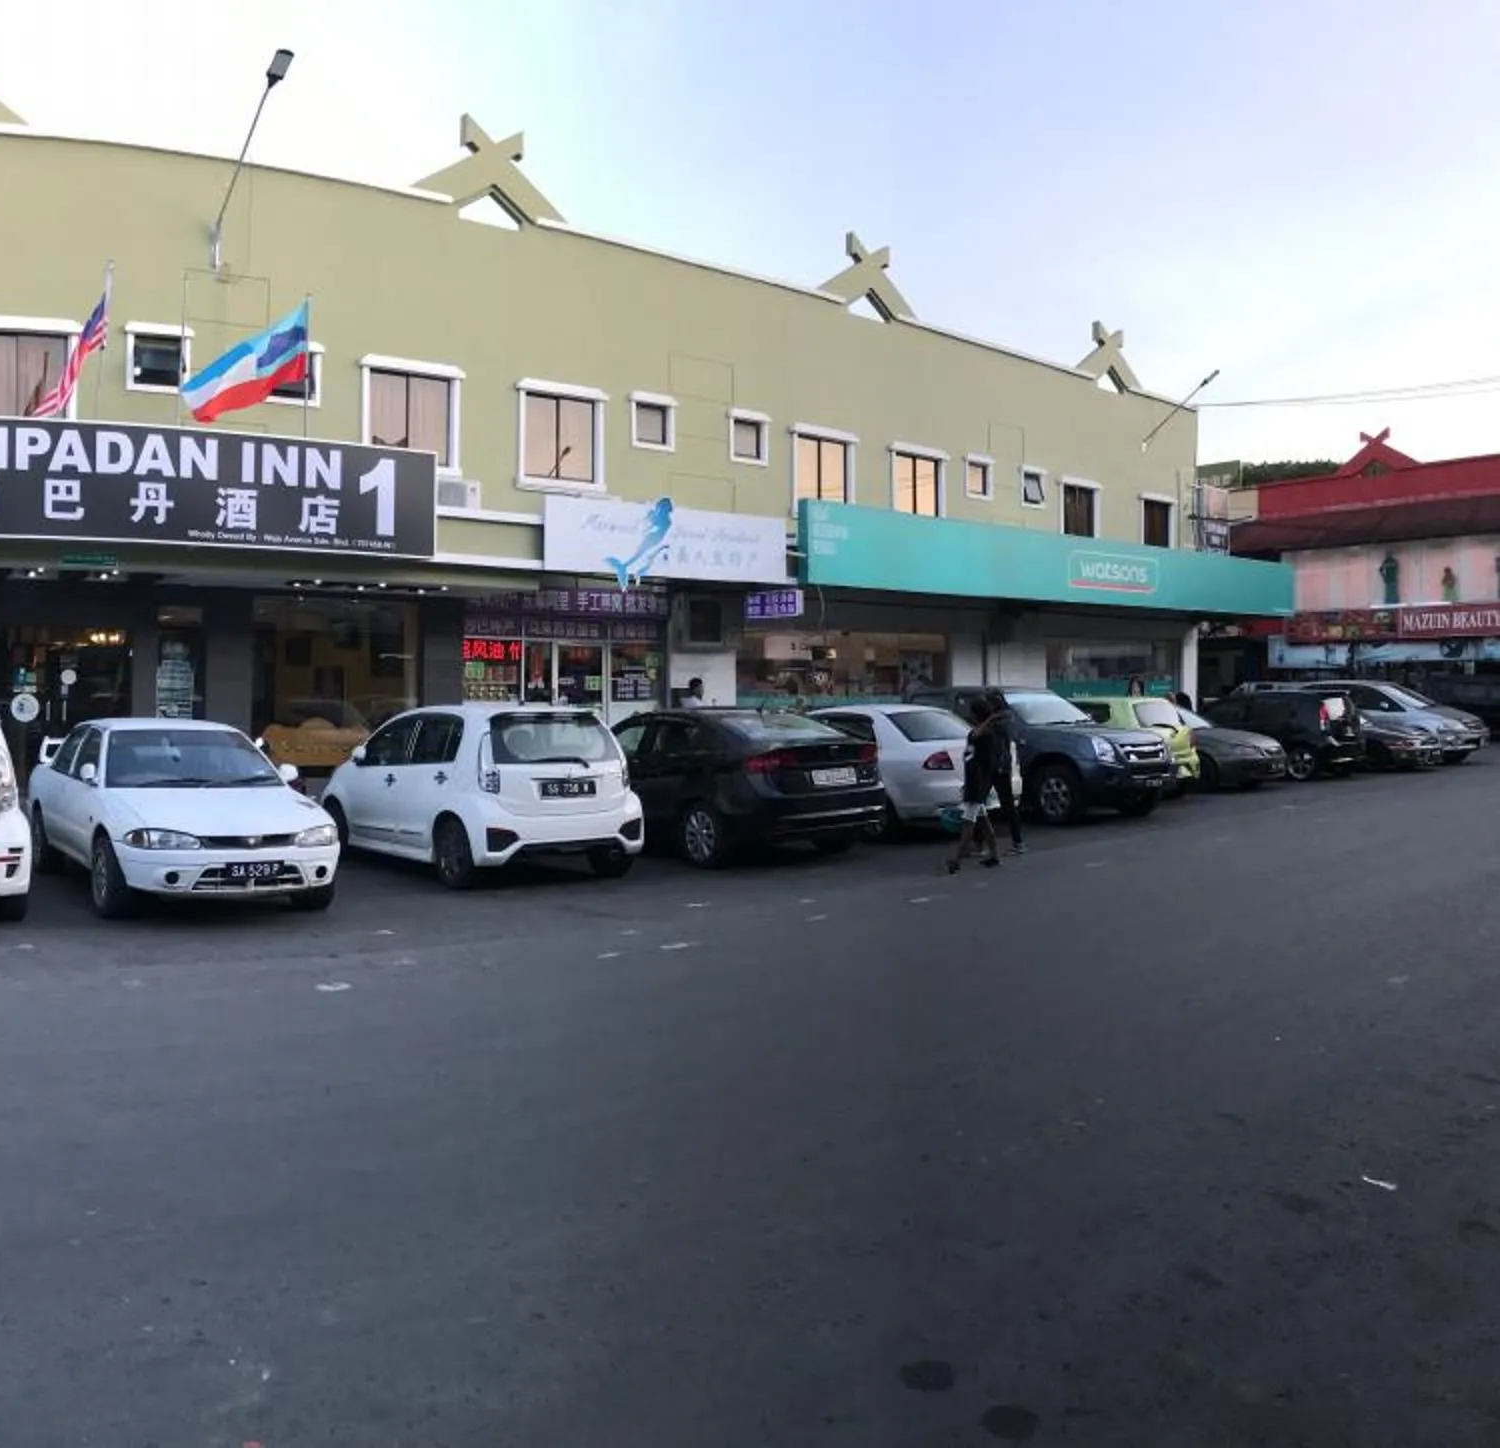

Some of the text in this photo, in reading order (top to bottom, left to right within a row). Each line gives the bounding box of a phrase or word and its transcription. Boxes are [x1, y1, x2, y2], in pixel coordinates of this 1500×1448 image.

[242, 442, 342, 489] INN
[359, 458, 397, 537] 1
[1080, 559, 1148, 583] watsons
